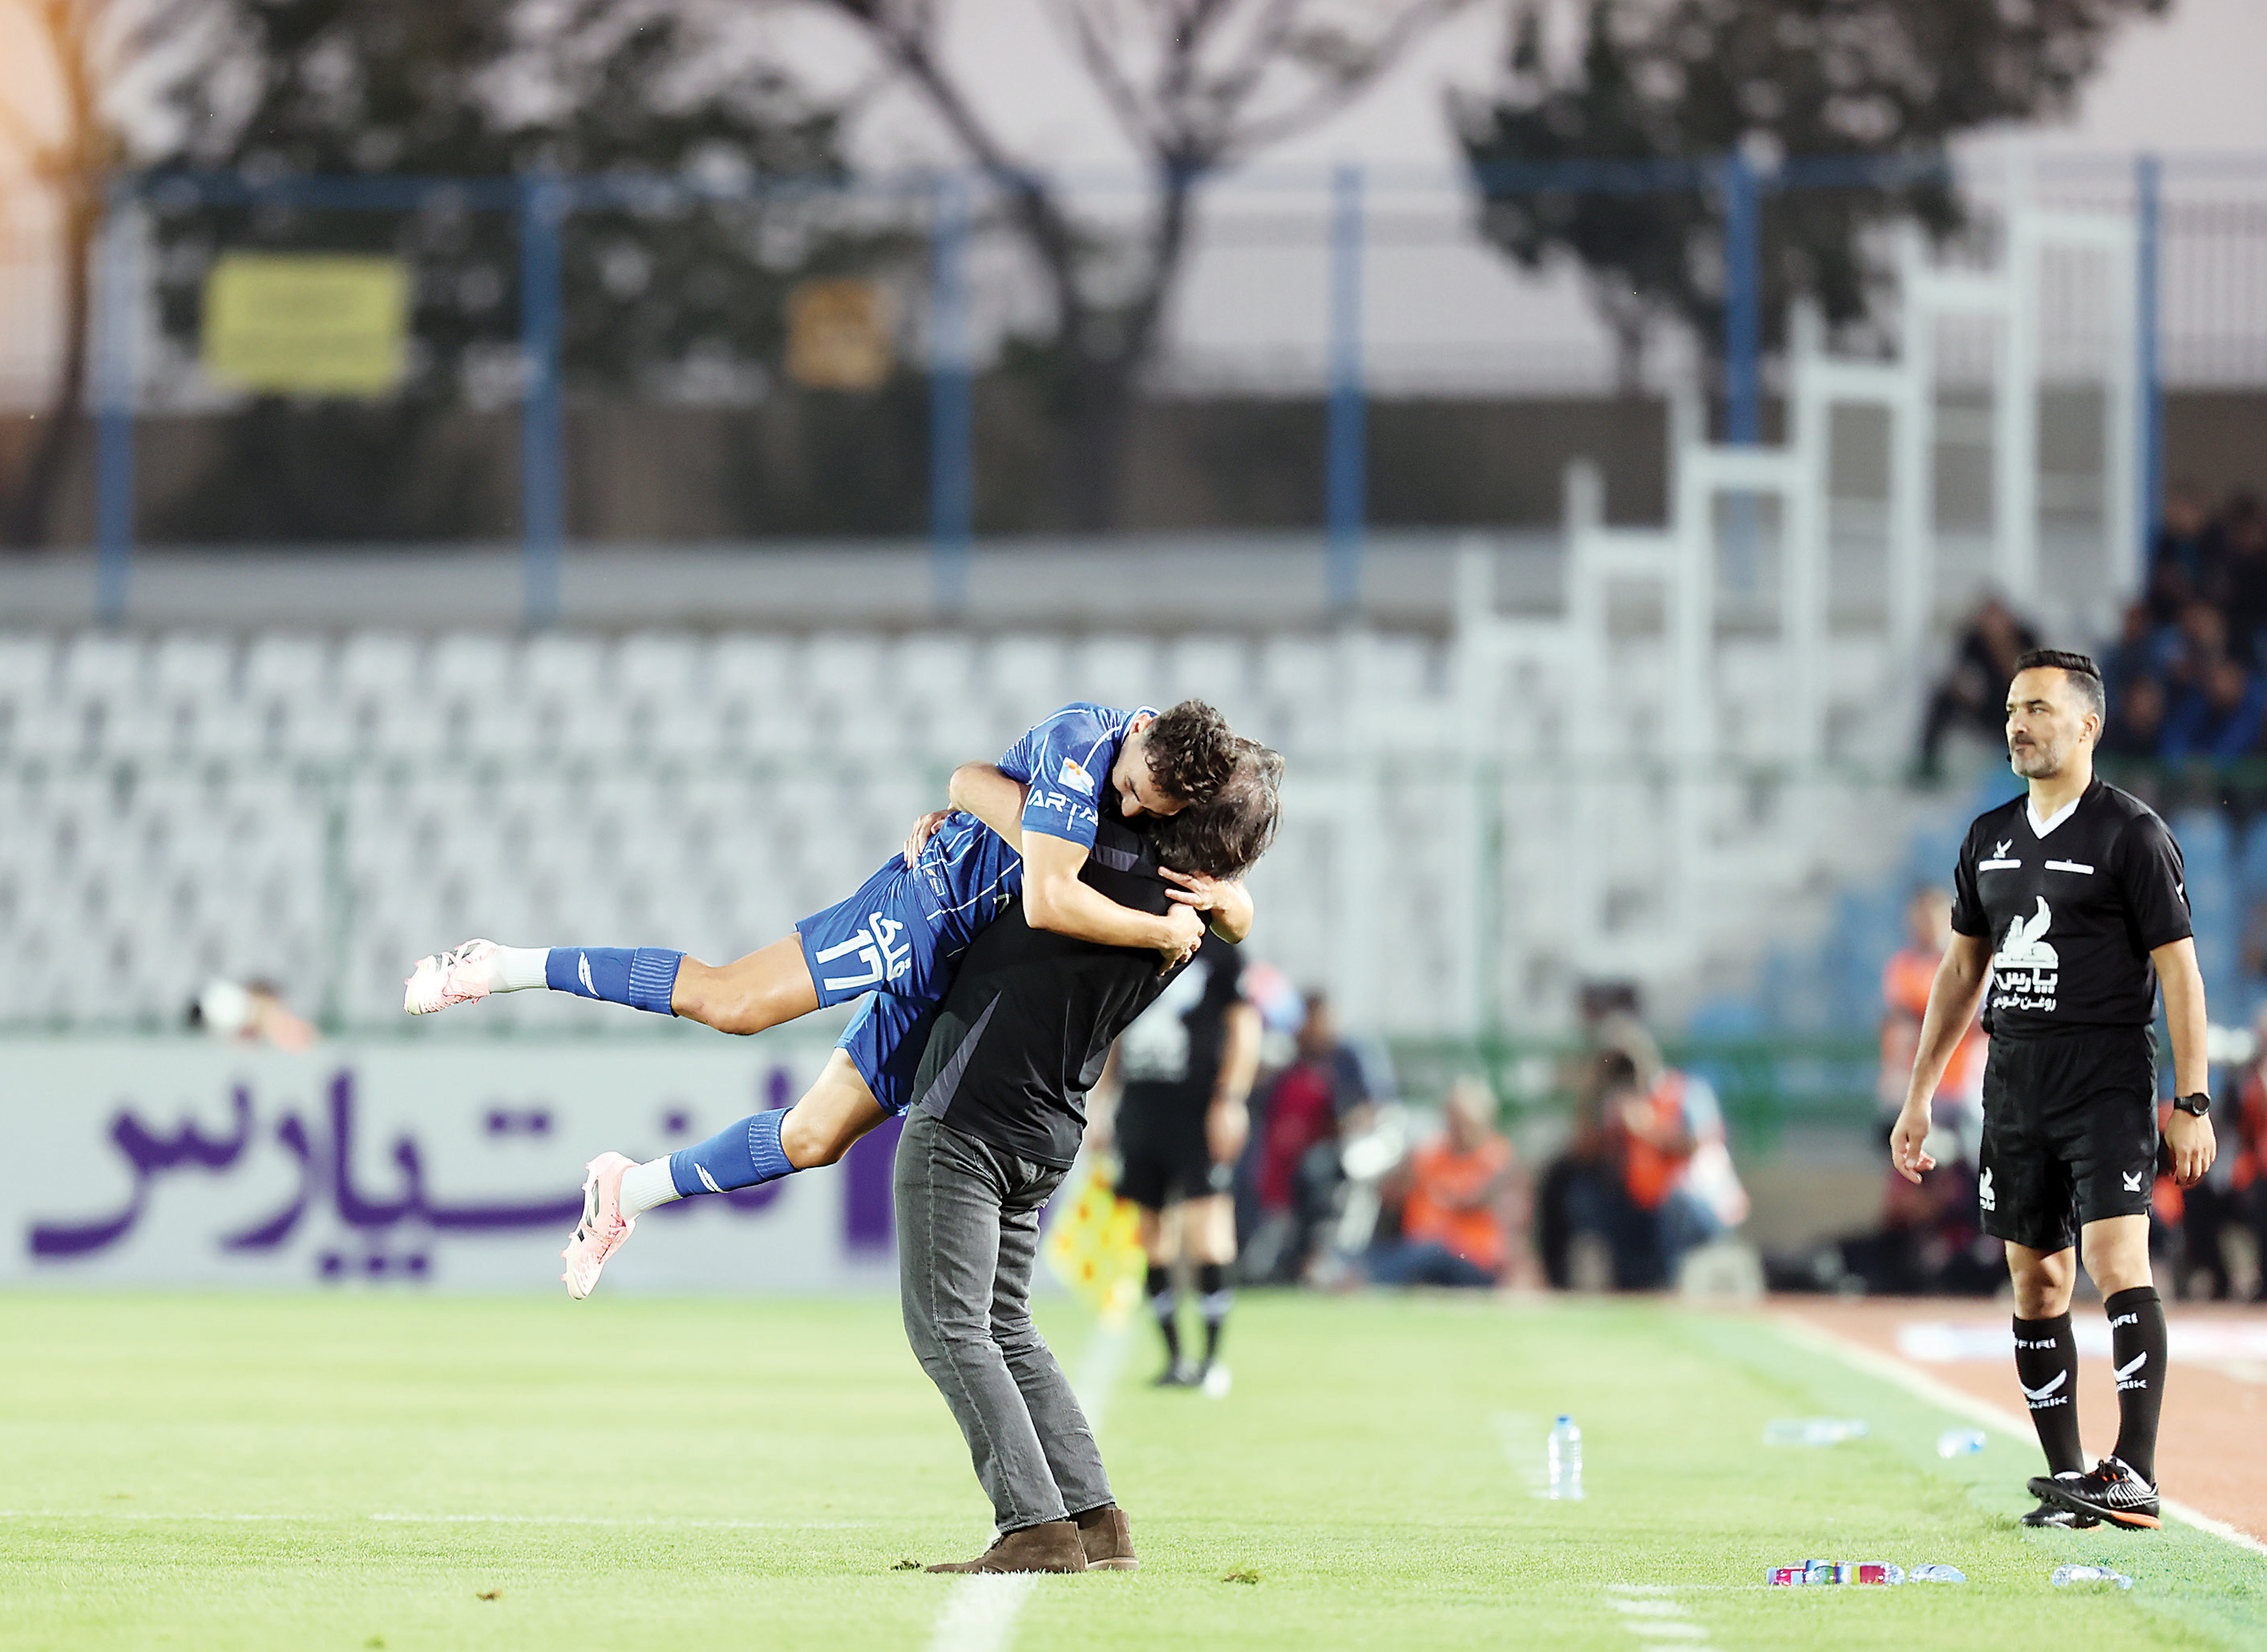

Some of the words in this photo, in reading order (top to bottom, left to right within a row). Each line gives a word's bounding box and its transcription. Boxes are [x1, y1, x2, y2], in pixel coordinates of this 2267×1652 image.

[815, 928, 883, 992] 17
[1994, 967, 2059, 994] پارس
[2020, 995, 2057, 1012] روغن
[24, 1068, 429, 1276] پارس
